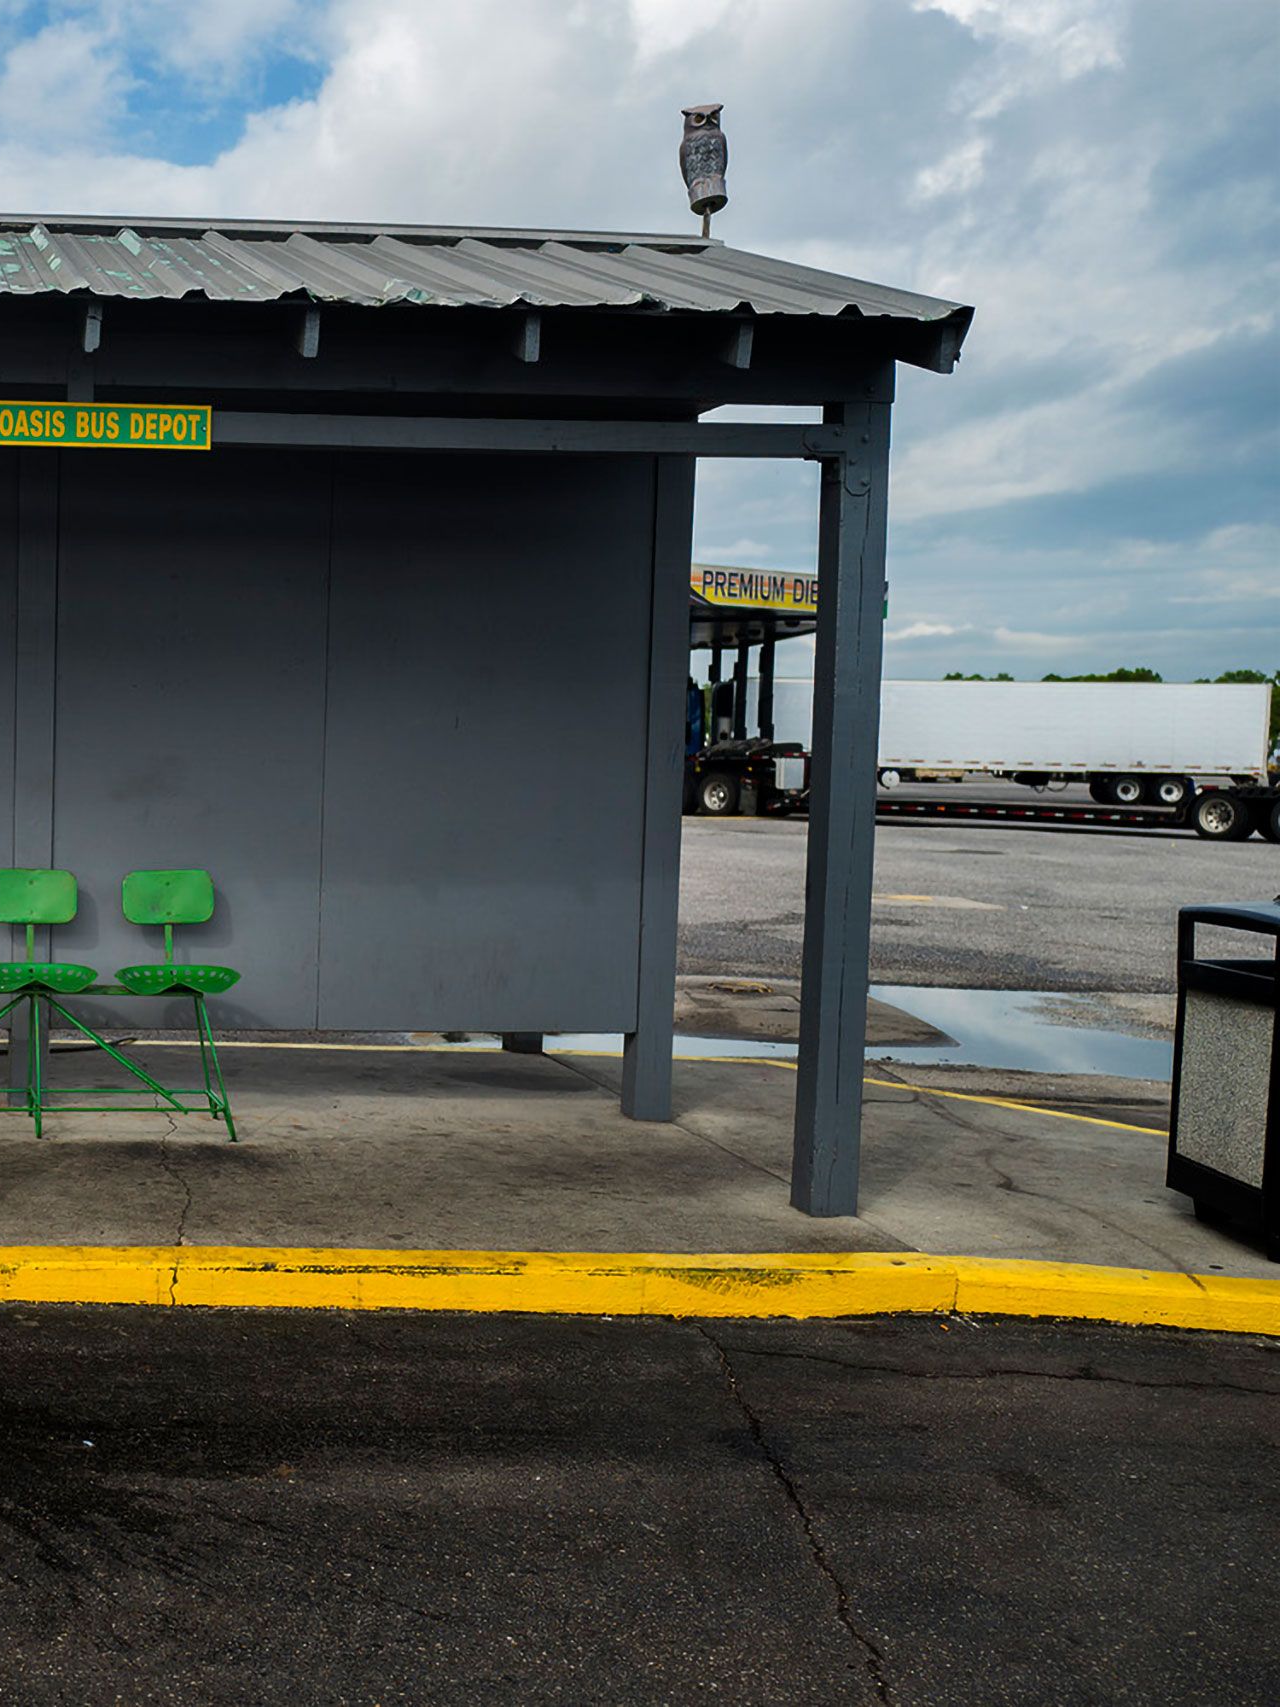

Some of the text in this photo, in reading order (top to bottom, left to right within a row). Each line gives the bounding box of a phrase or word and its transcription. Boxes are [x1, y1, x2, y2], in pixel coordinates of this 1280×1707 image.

[76, 411, 119, 439] BUS
[130, 413, 200, 441] DEPOT
[702, 570, 785, 602] PREMIUM
